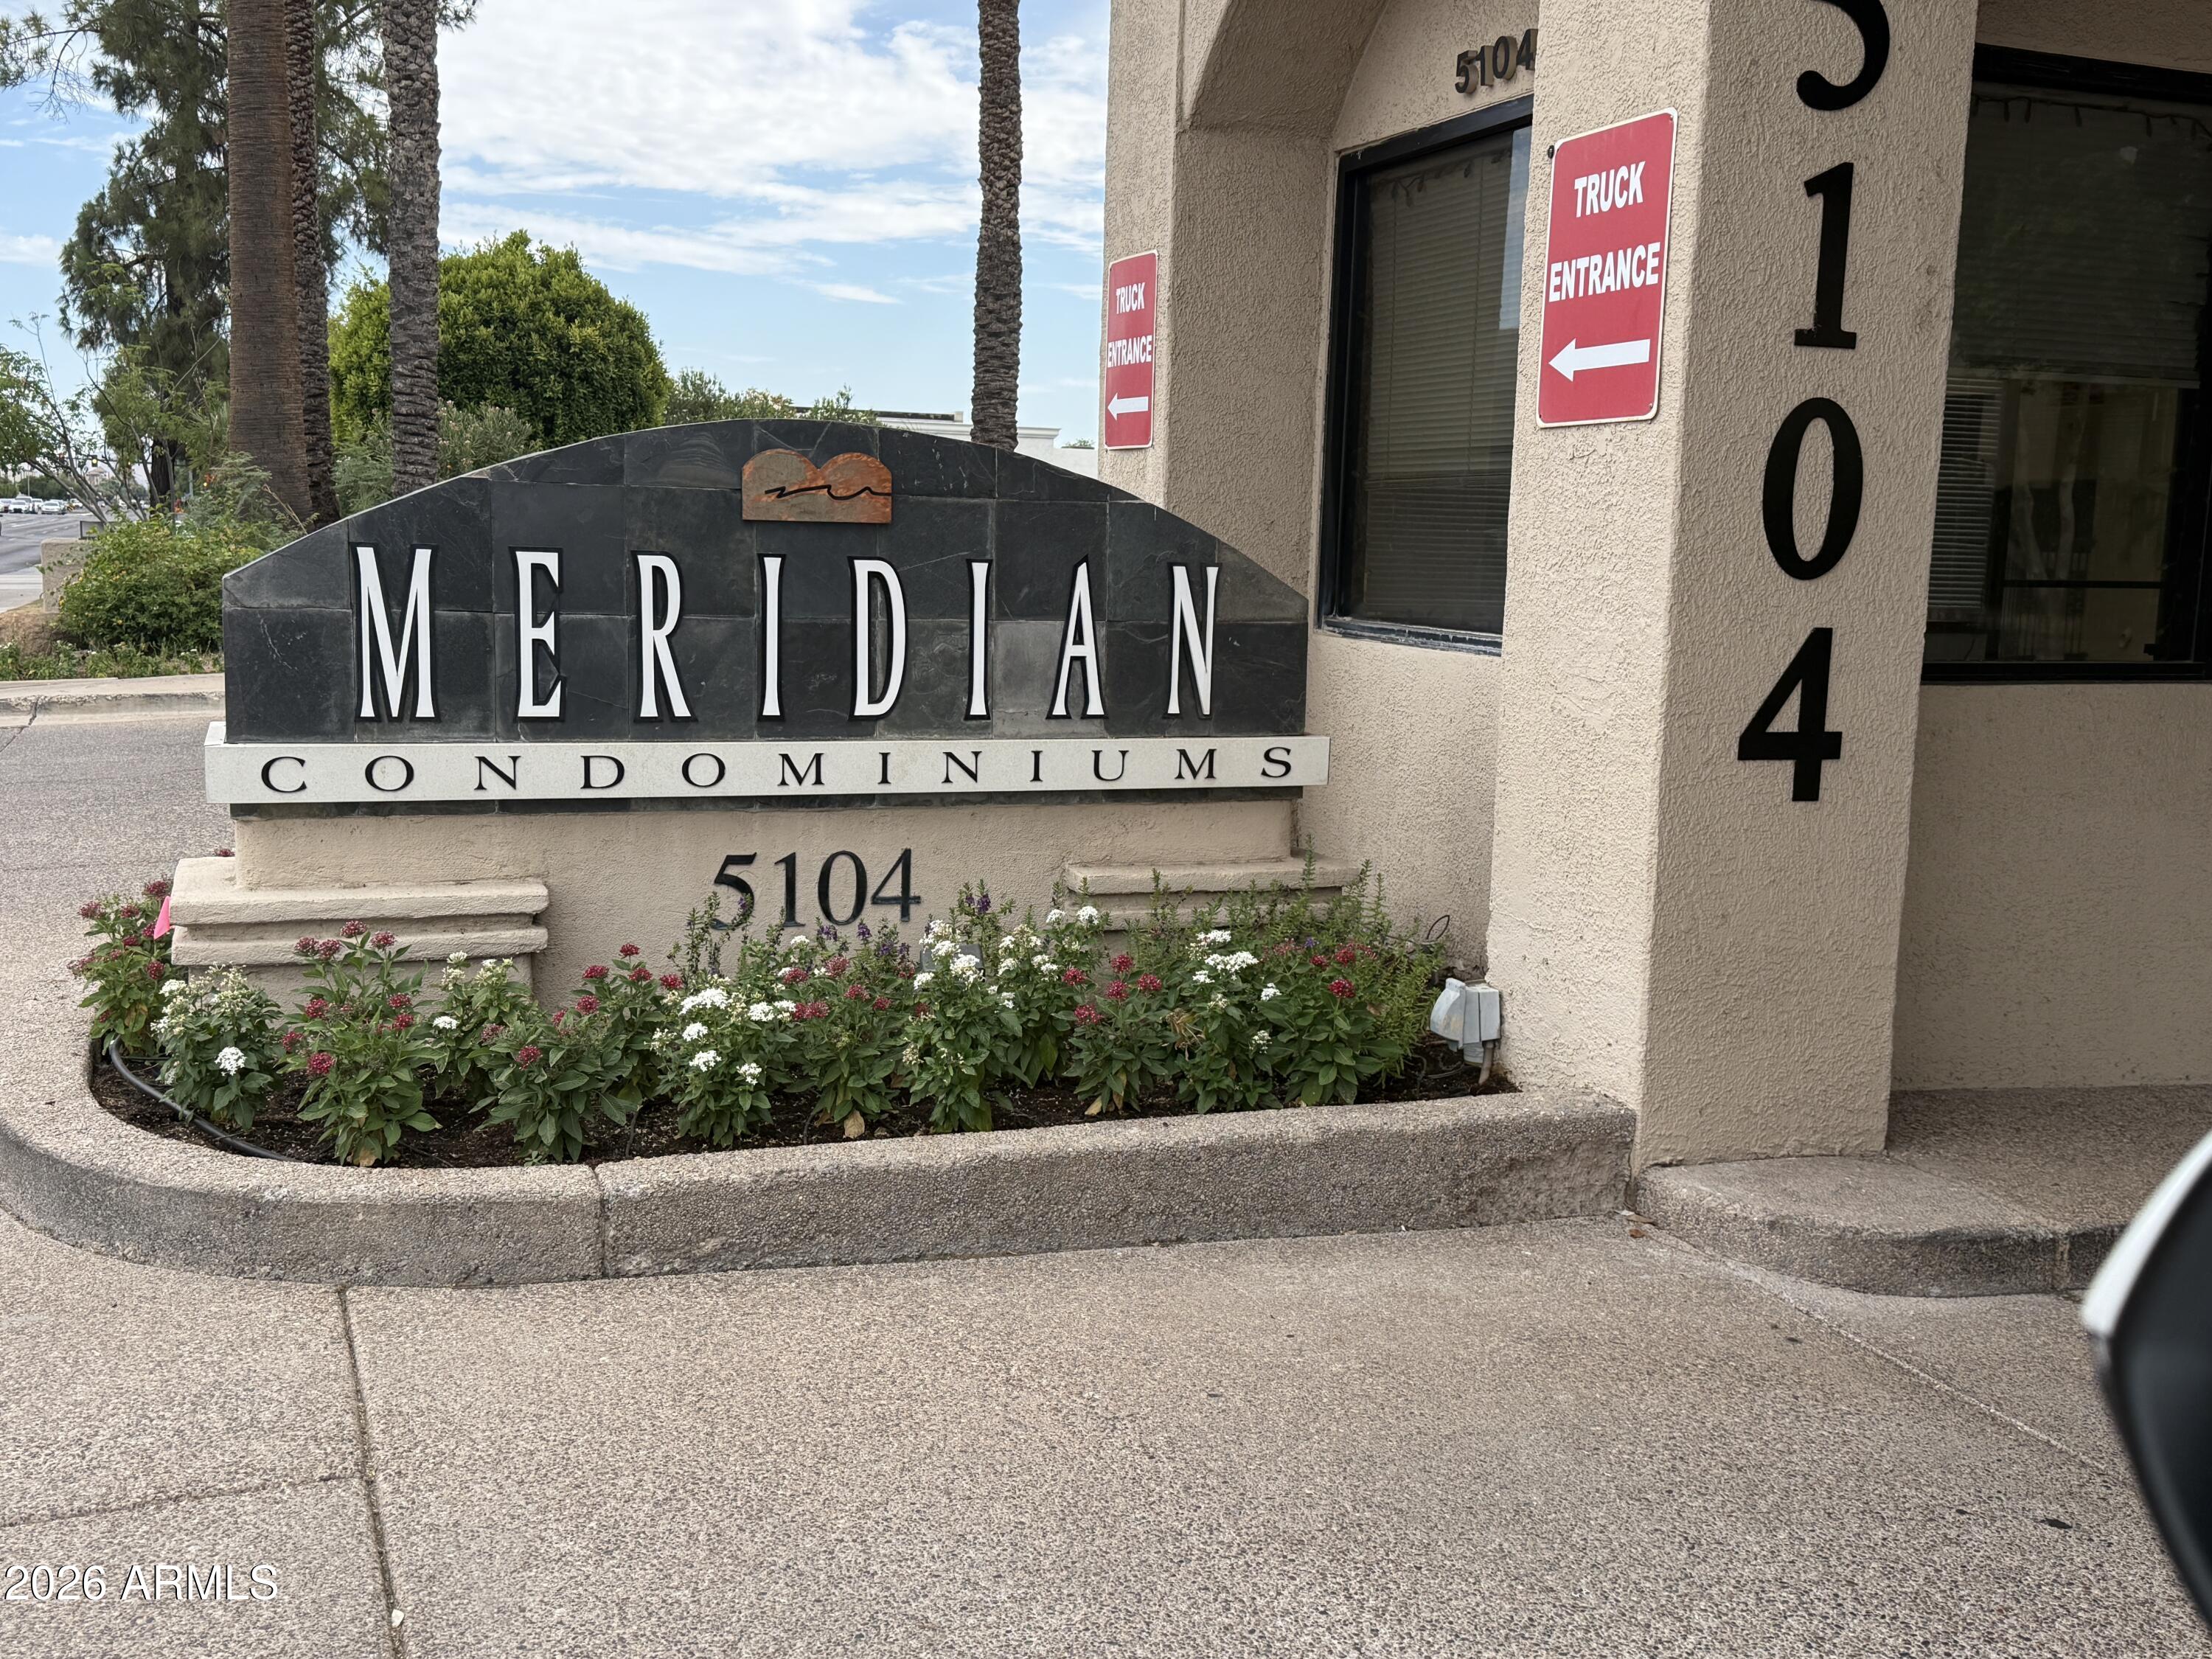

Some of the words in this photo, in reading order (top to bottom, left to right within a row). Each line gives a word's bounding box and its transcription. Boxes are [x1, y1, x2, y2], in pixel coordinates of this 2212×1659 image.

[1455, 29, 1537, 94] 5104
[1574, 161, 1646, 218] TRUCK
[1116, 282, 1146, 314] TRUCK
[1548, 242, 1660, 302] ENTRANCE
[1107, 335, 1152, 368] ENTRANCE
[352, 544, 1220, 720] MERIDIAN
[260, 746, 1293, 793] CONDOMINIUMS
[709, 848, 922, 931] 5104
